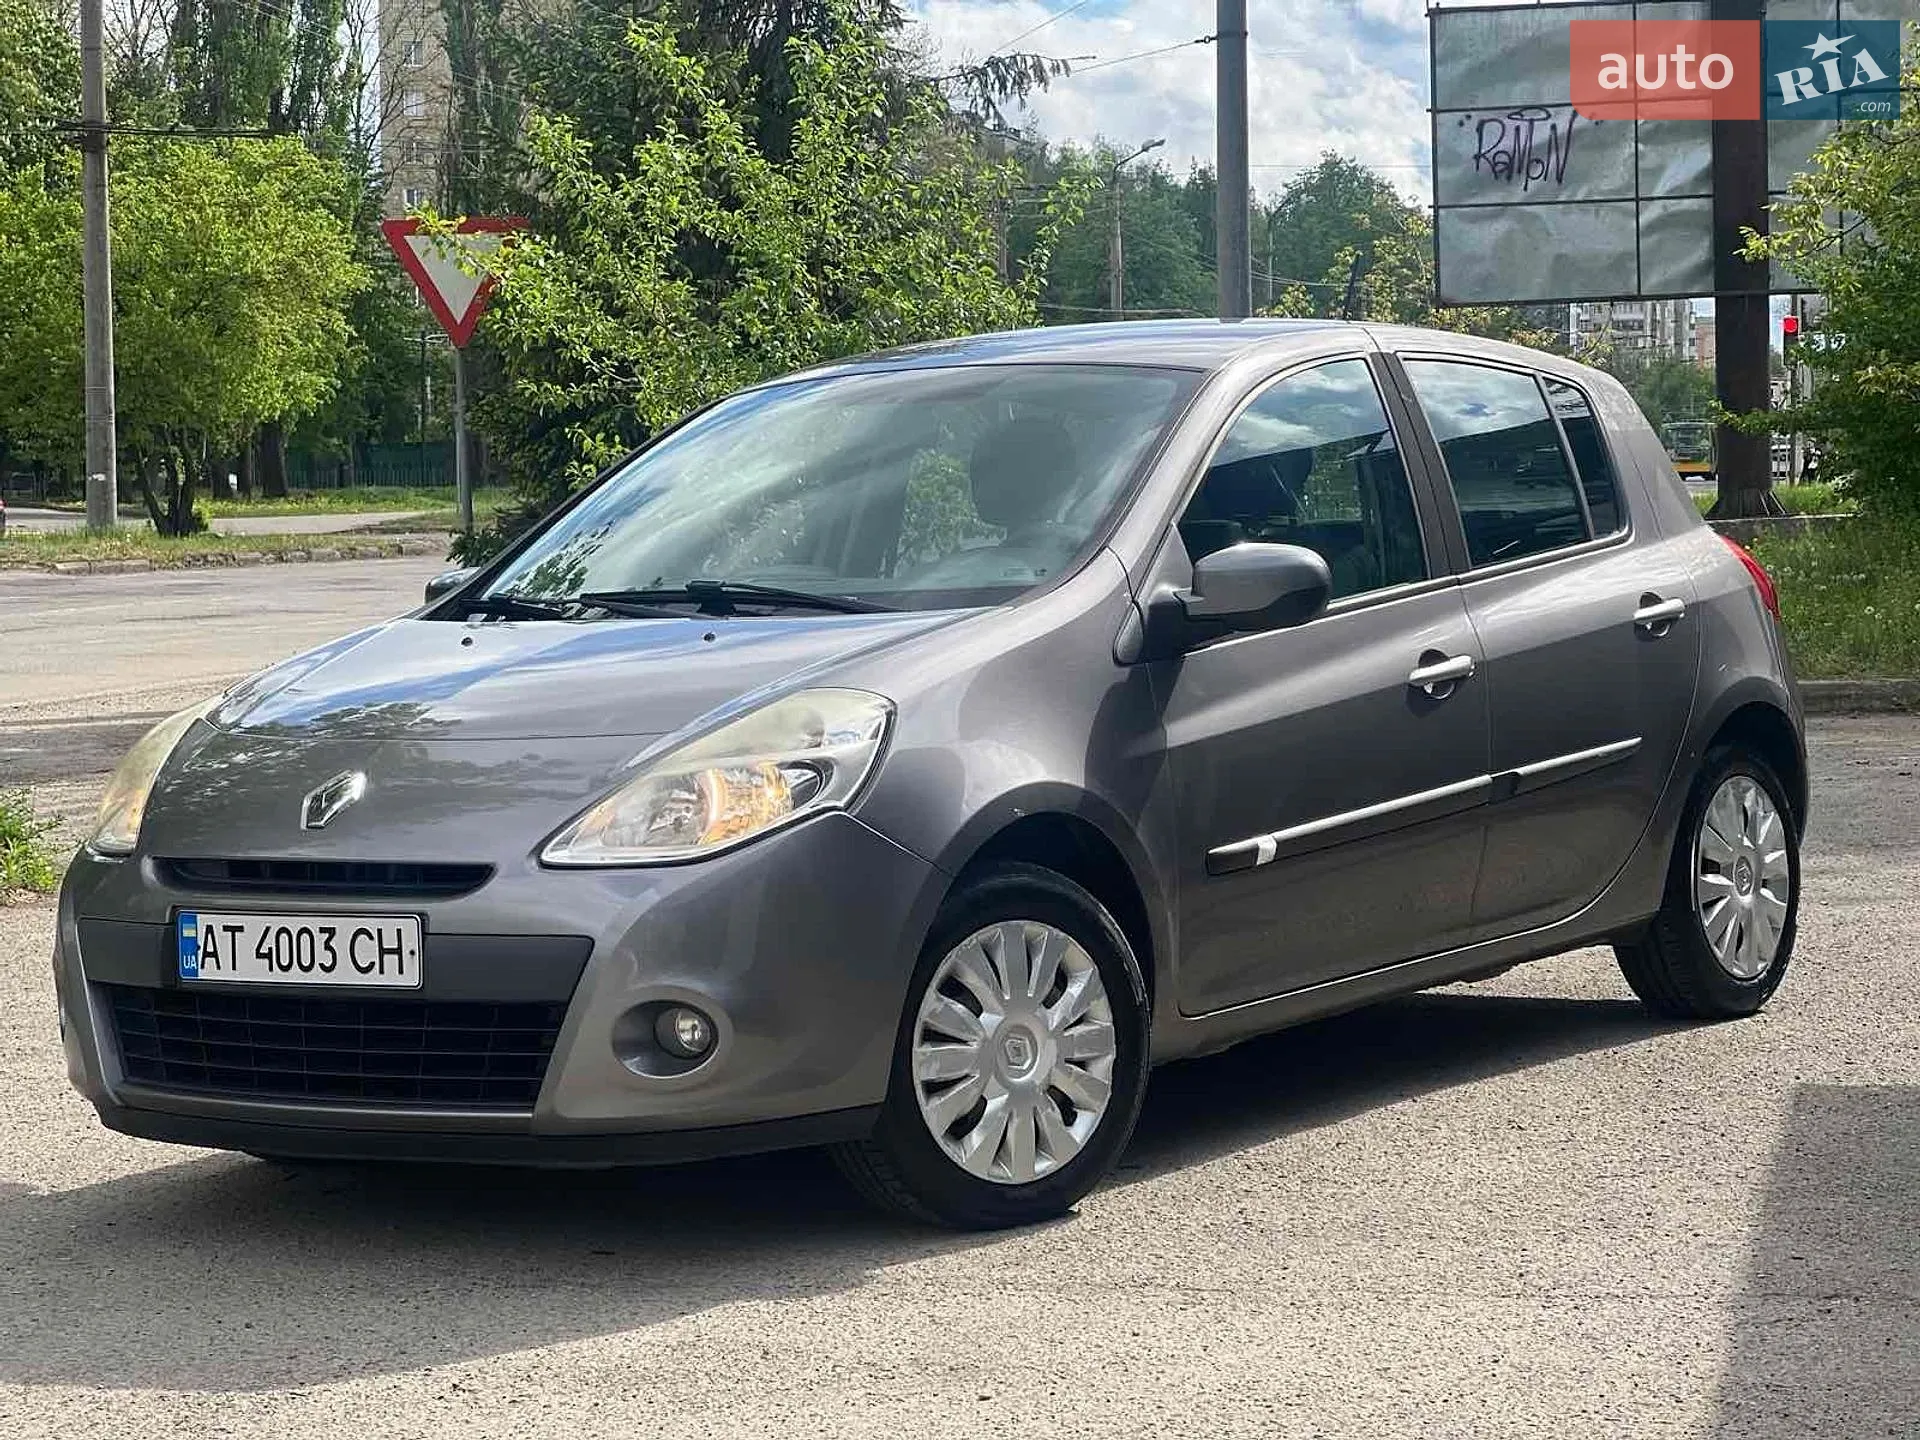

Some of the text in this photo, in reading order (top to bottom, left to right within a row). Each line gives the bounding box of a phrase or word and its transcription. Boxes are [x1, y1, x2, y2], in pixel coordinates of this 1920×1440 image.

[183, 954, 197, 970] UA
[200, 924, 404, 975] AT 4003 CH
